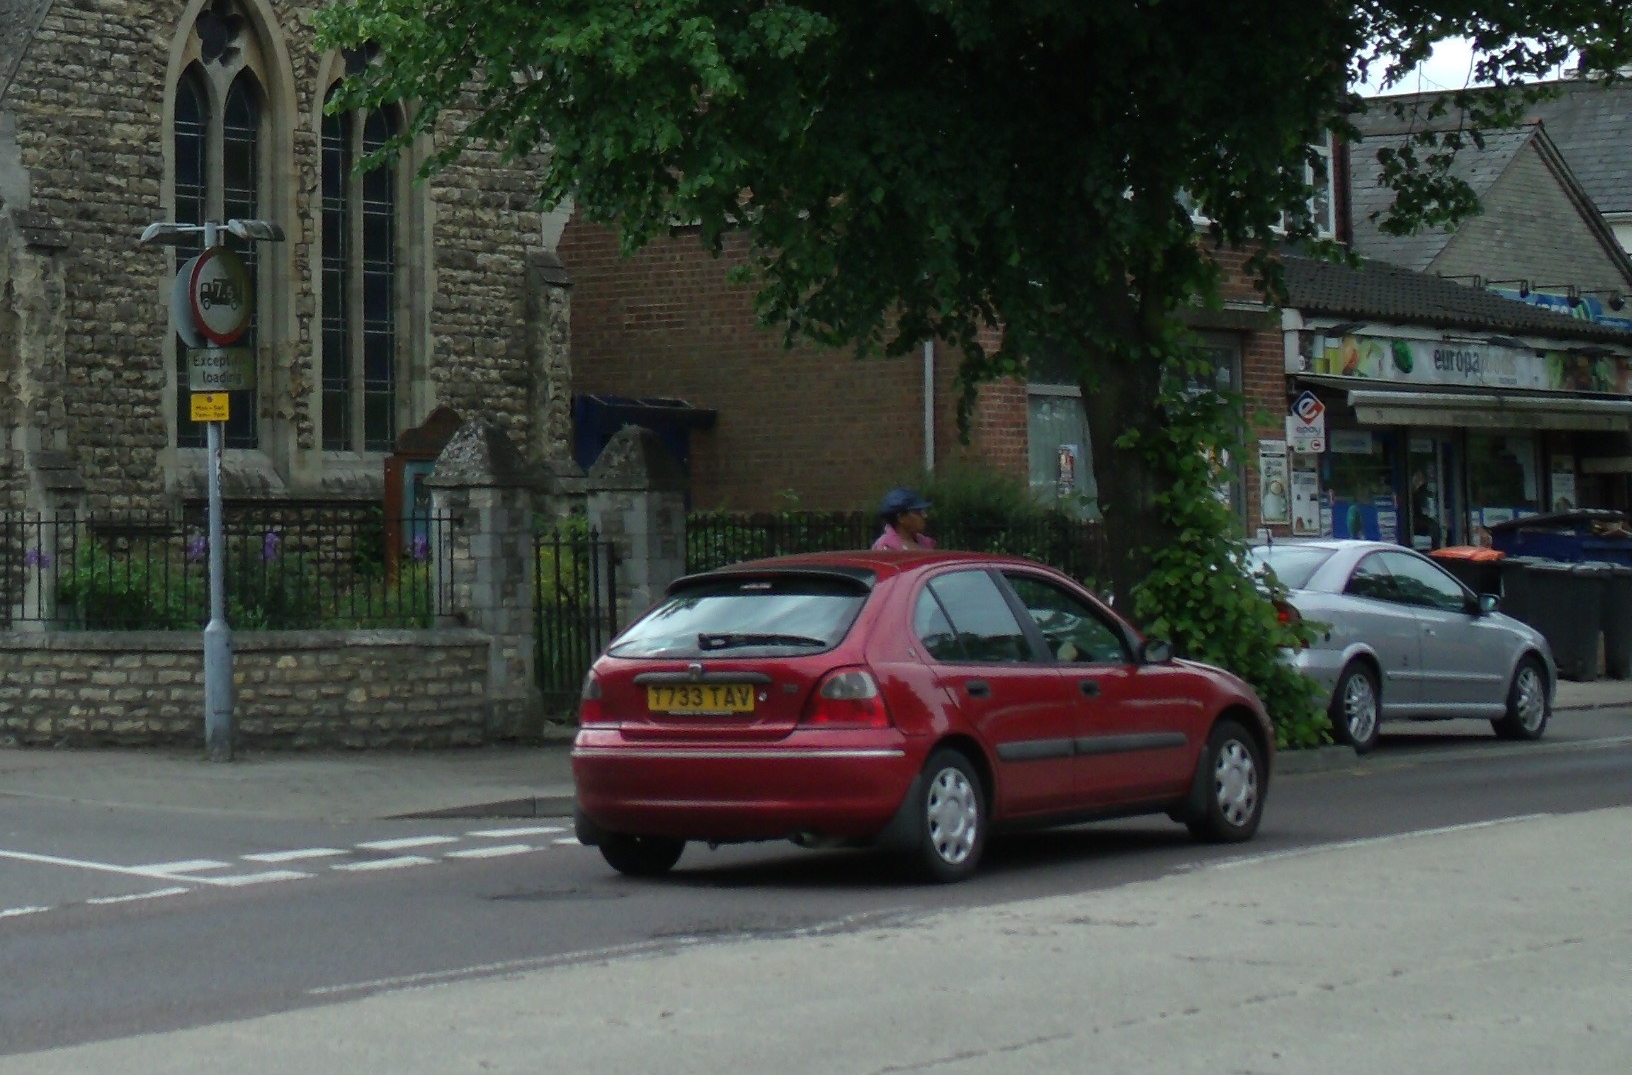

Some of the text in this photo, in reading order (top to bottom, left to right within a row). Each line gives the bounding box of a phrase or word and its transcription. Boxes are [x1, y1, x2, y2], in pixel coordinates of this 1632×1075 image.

[214, 281, 234, 299] 7.5
[652, 685, 751, 707] T733 TAV
